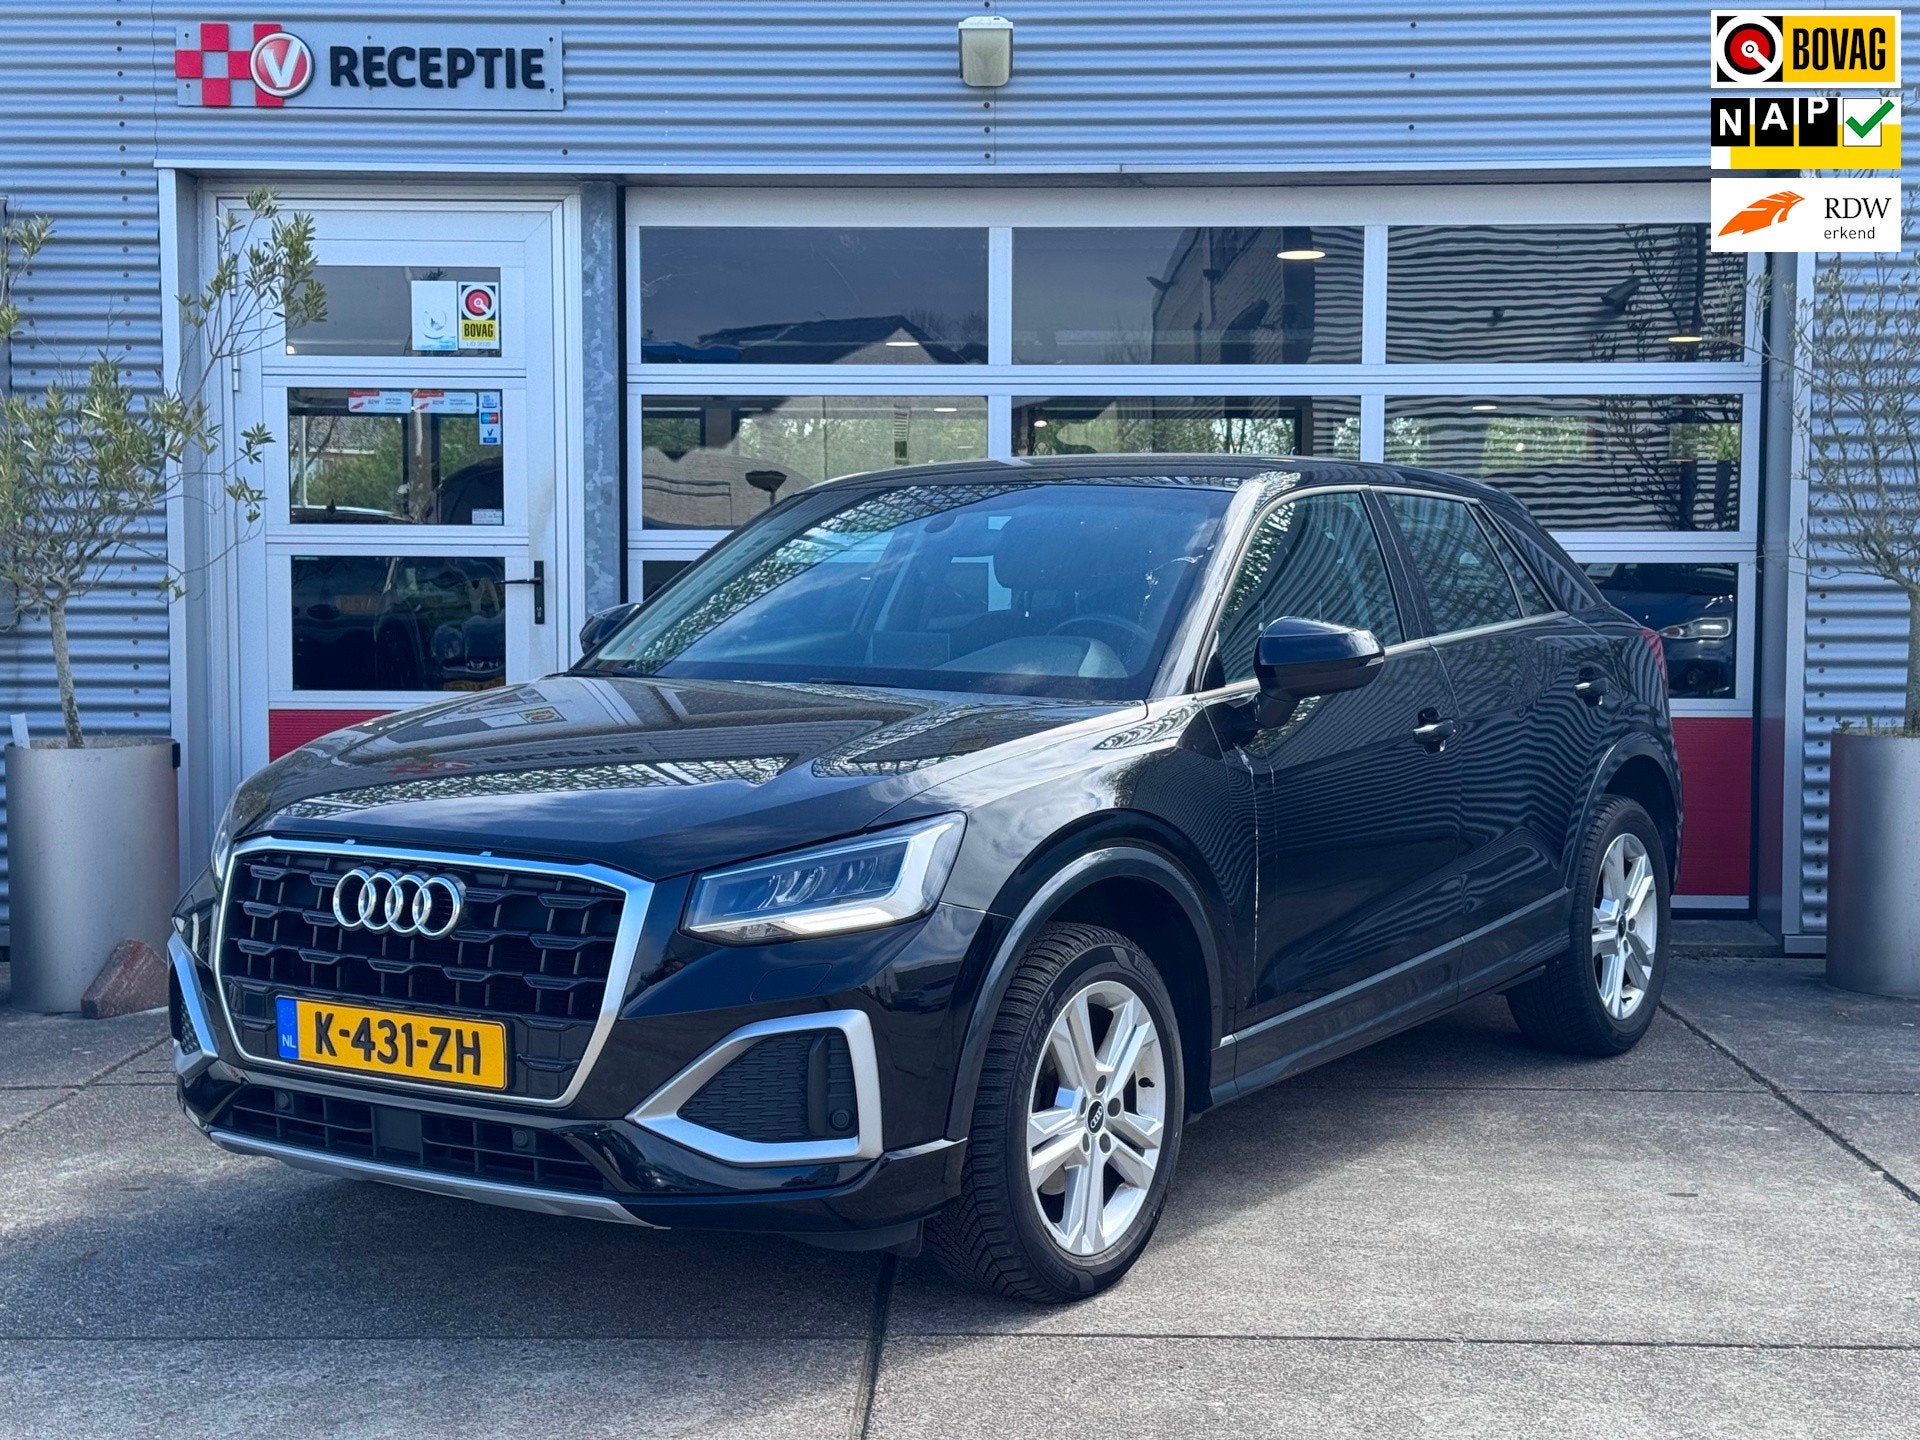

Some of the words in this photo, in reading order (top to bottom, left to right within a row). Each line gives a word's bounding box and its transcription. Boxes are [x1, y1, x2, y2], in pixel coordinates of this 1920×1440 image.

[330, 46, 545, 89] RECEPTIE
[464, 323, 494, 338] BOVAG
[282, 1034, 296, 1049] NL
[314, 1011, 482, 1076] K-431-ZH
